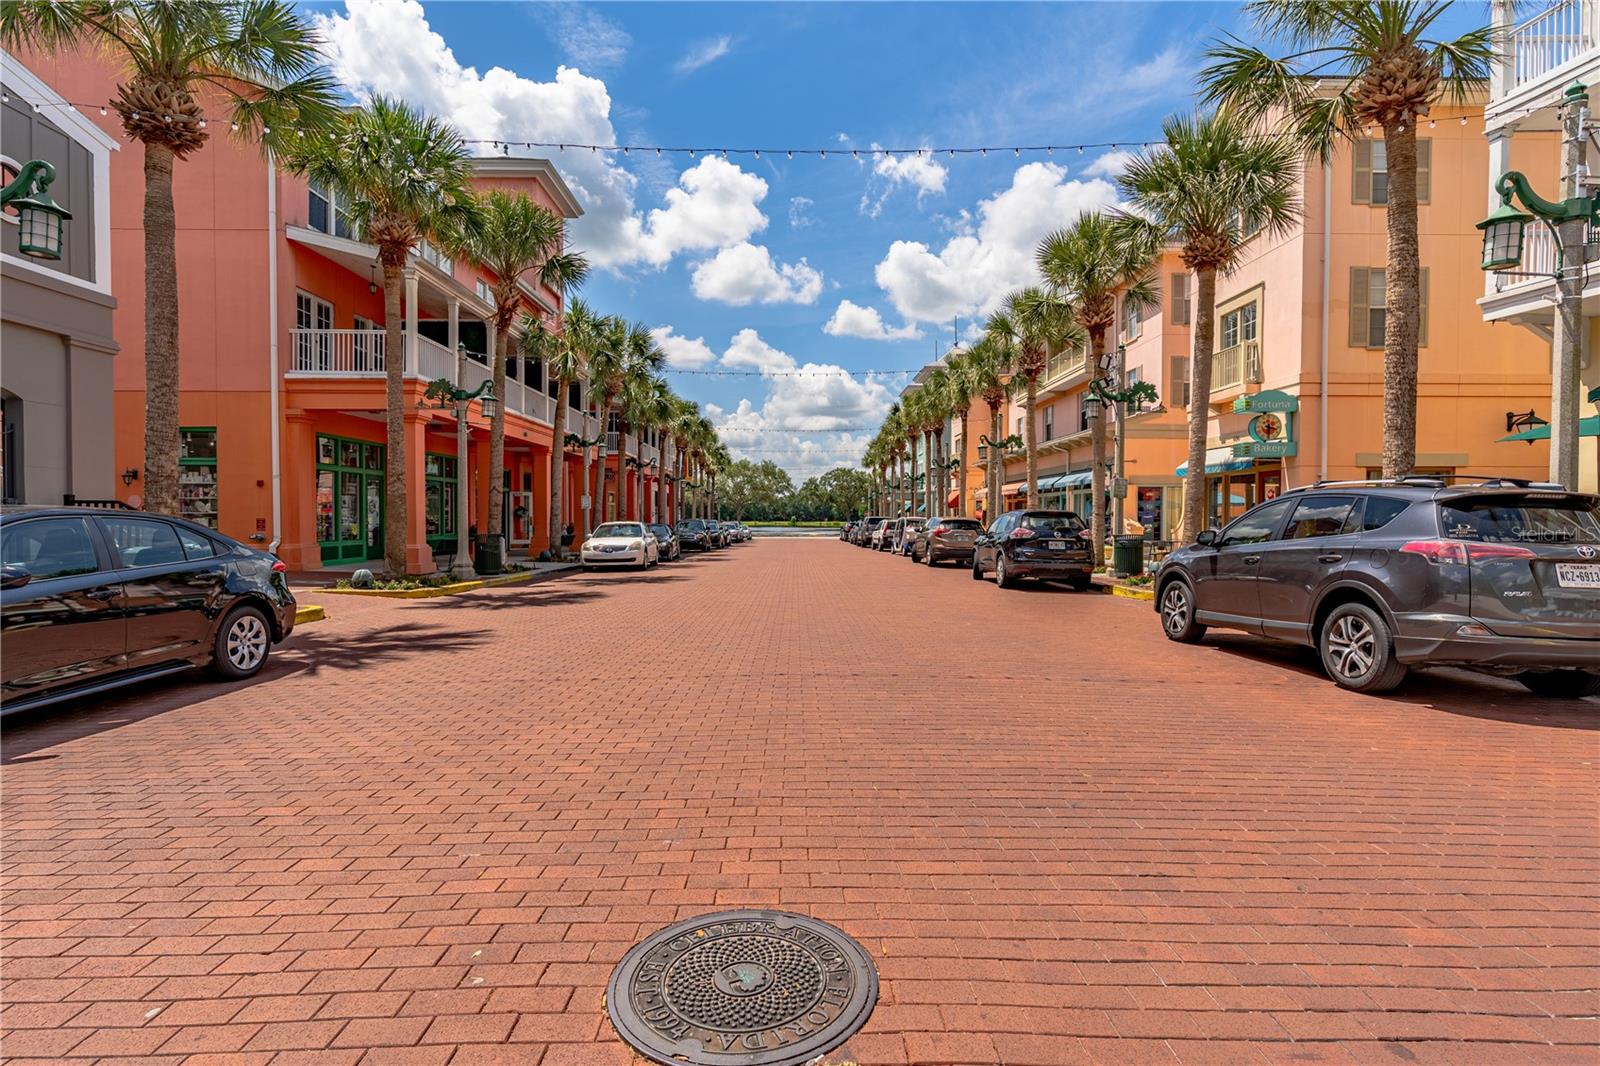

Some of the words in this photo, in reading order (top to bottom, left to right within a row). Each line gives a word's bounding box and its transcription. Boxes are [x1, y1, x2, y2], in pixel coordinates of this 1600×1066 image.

[1252, 399, 1291, 408] Fortuna
[1254, 443, 1287, 453] Bakery
[669, 921, 848, 975] CELEBRATION
[643, 1001, 692, 1038] 1994
[716, 987, 849, 1051] FLORIDA
